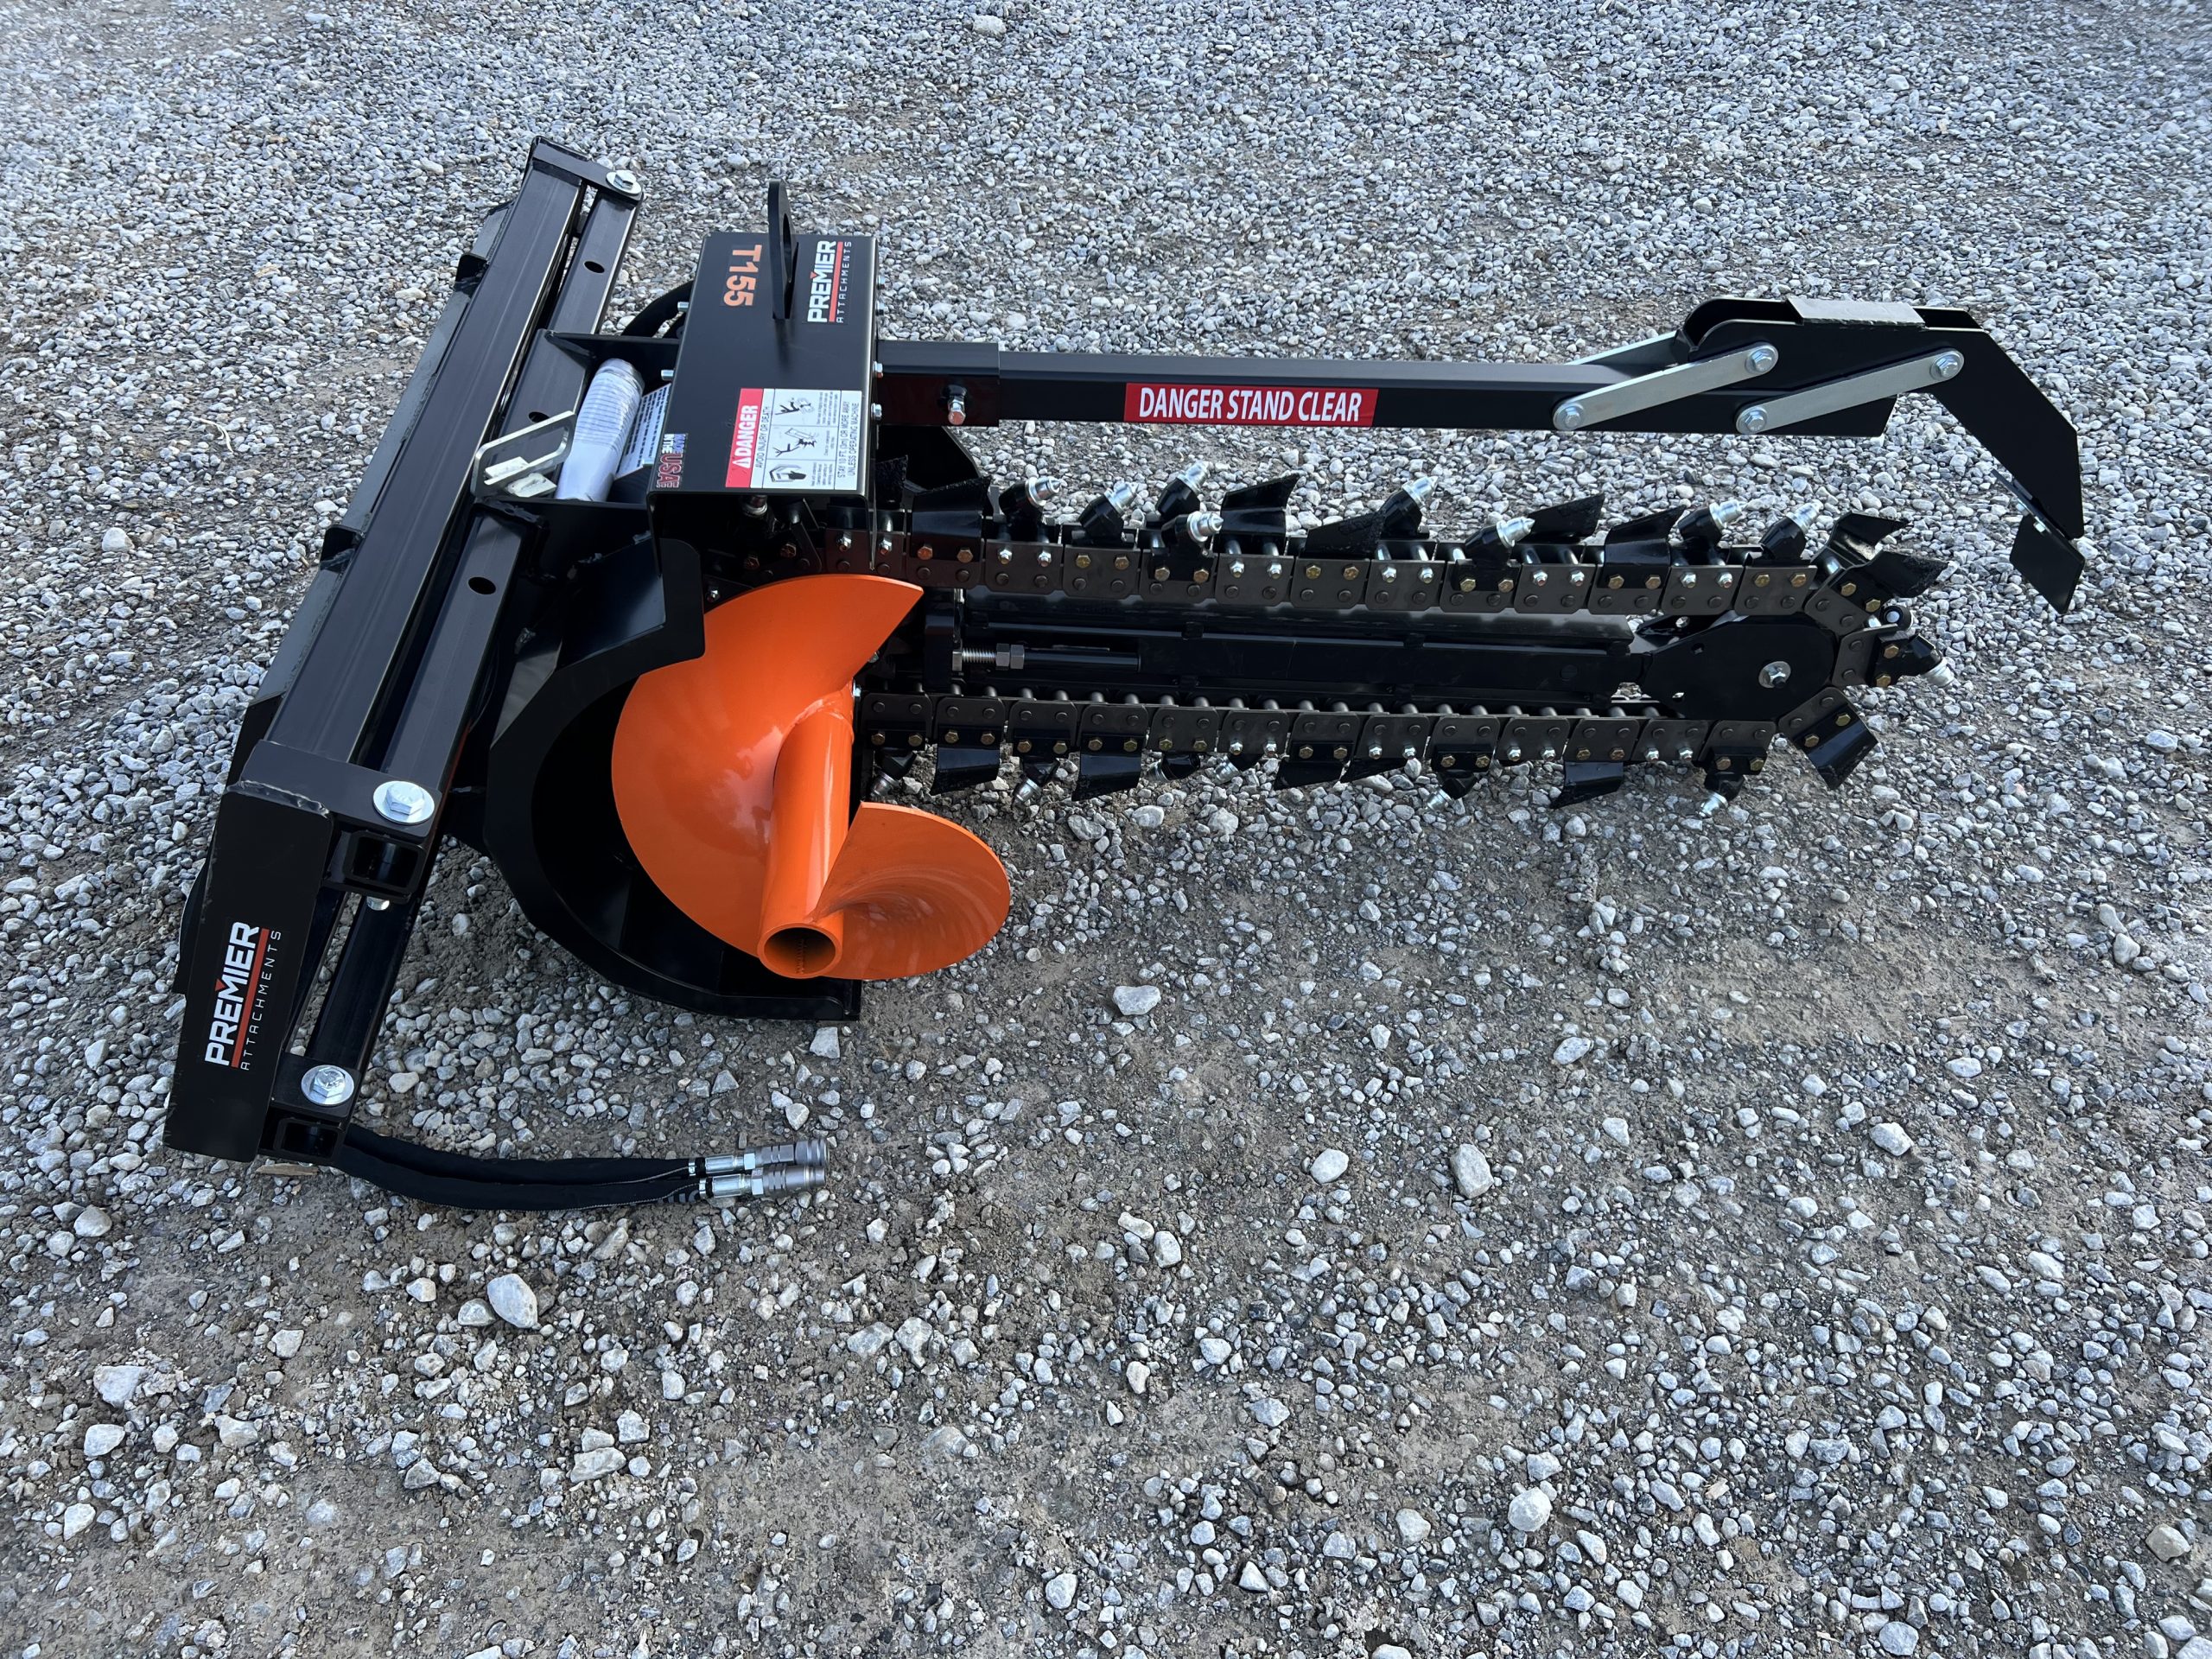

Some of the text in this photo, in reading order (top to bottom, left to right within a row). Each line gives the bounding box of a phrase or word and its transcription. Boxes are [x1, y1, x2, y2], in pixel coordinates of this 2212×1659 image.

[723, 245, 762, 306] T155
[807, 240, 836, 322] PREMIER
[836, 241, 852, 323] ATTACHMENTS
[761, 406, 771, 423] DEATH
[841, 415, 849, 429] MORE
[1140, 388, 1362, 423] DANGER STAND CLEAR
[662, 441, 674, 454] THE
[734, 405, 759, 457] DANGER
[757, 432, 768, 452] INJURY
[848, 403, 859, 476] UNLESS OPERATING MACHINE
[658, 453, 683, 483] USA
[755, 452, 765, 468] AVOID
[837, 466, 846, 478] STAY
[205, 921, 259, 1066] PREMIER
[240, 930, 282, 1071] ATTACHMENTS
